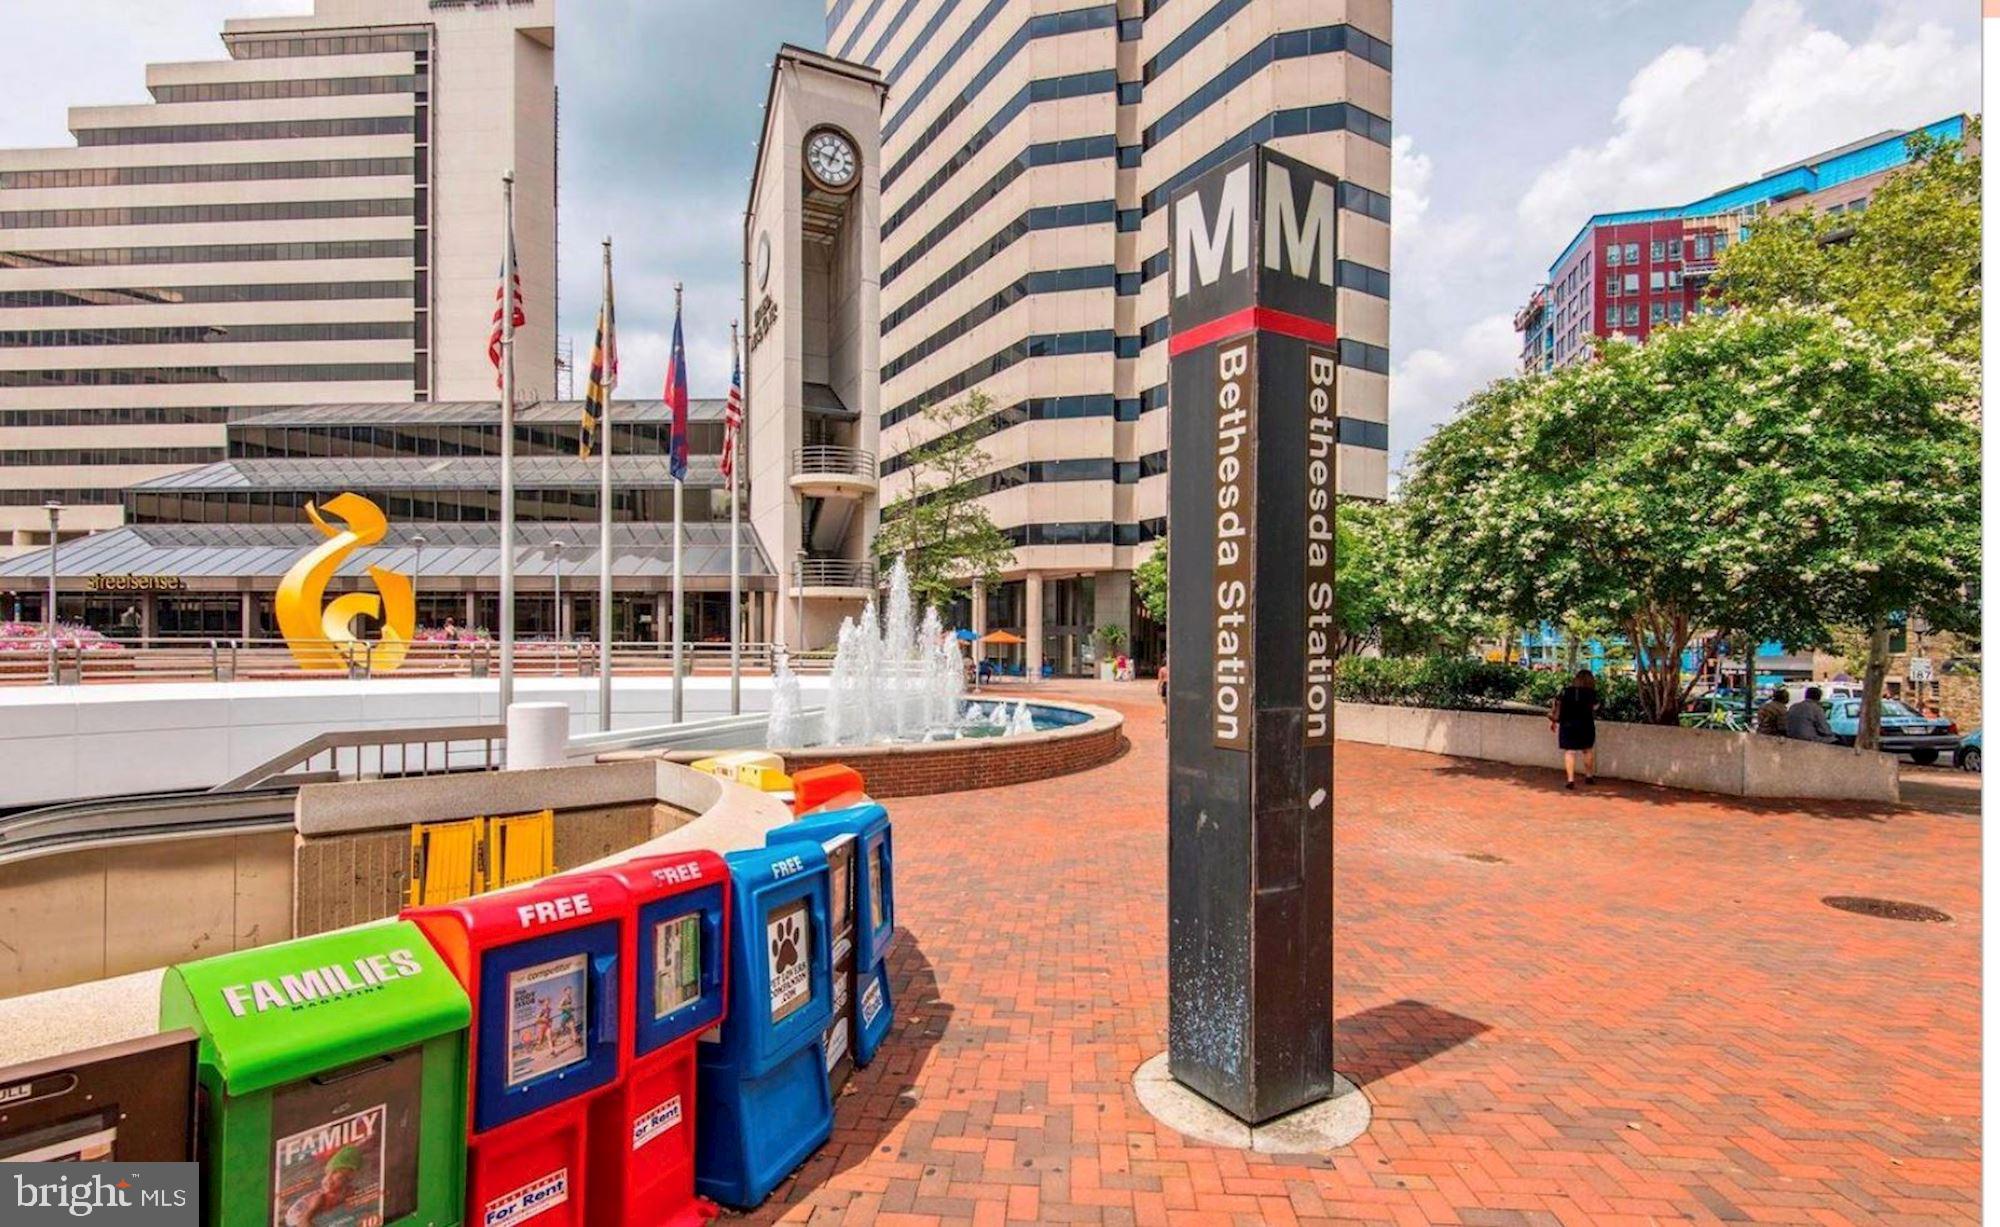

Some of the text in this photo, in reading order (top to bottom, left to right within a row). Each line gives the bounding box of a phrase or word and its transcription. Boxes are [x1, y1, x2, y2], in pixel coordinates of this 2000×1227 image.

[1175, 162, 1250, 298] M
[1264, 161, 1334, 287] M
[1217, 345, 1247, 740] Bethesda Station
[1307, 355, 1334, 738] Bethesda Station
[653, 861, 702, 888] FREE
[770, 855, 803, 880] FREE
[517, 893, 592, 929] FREE
[221, 948, 423, 1018] FAMILIES
[292, 985, 385, 1012] MAGAZINE
[284, 1112, 379, 1166] FAMILY
[650, 1105, 678, 1127] Rent
[486, 1203, 517, 1225] For
[522, 1180, 564, 1207] Rent
